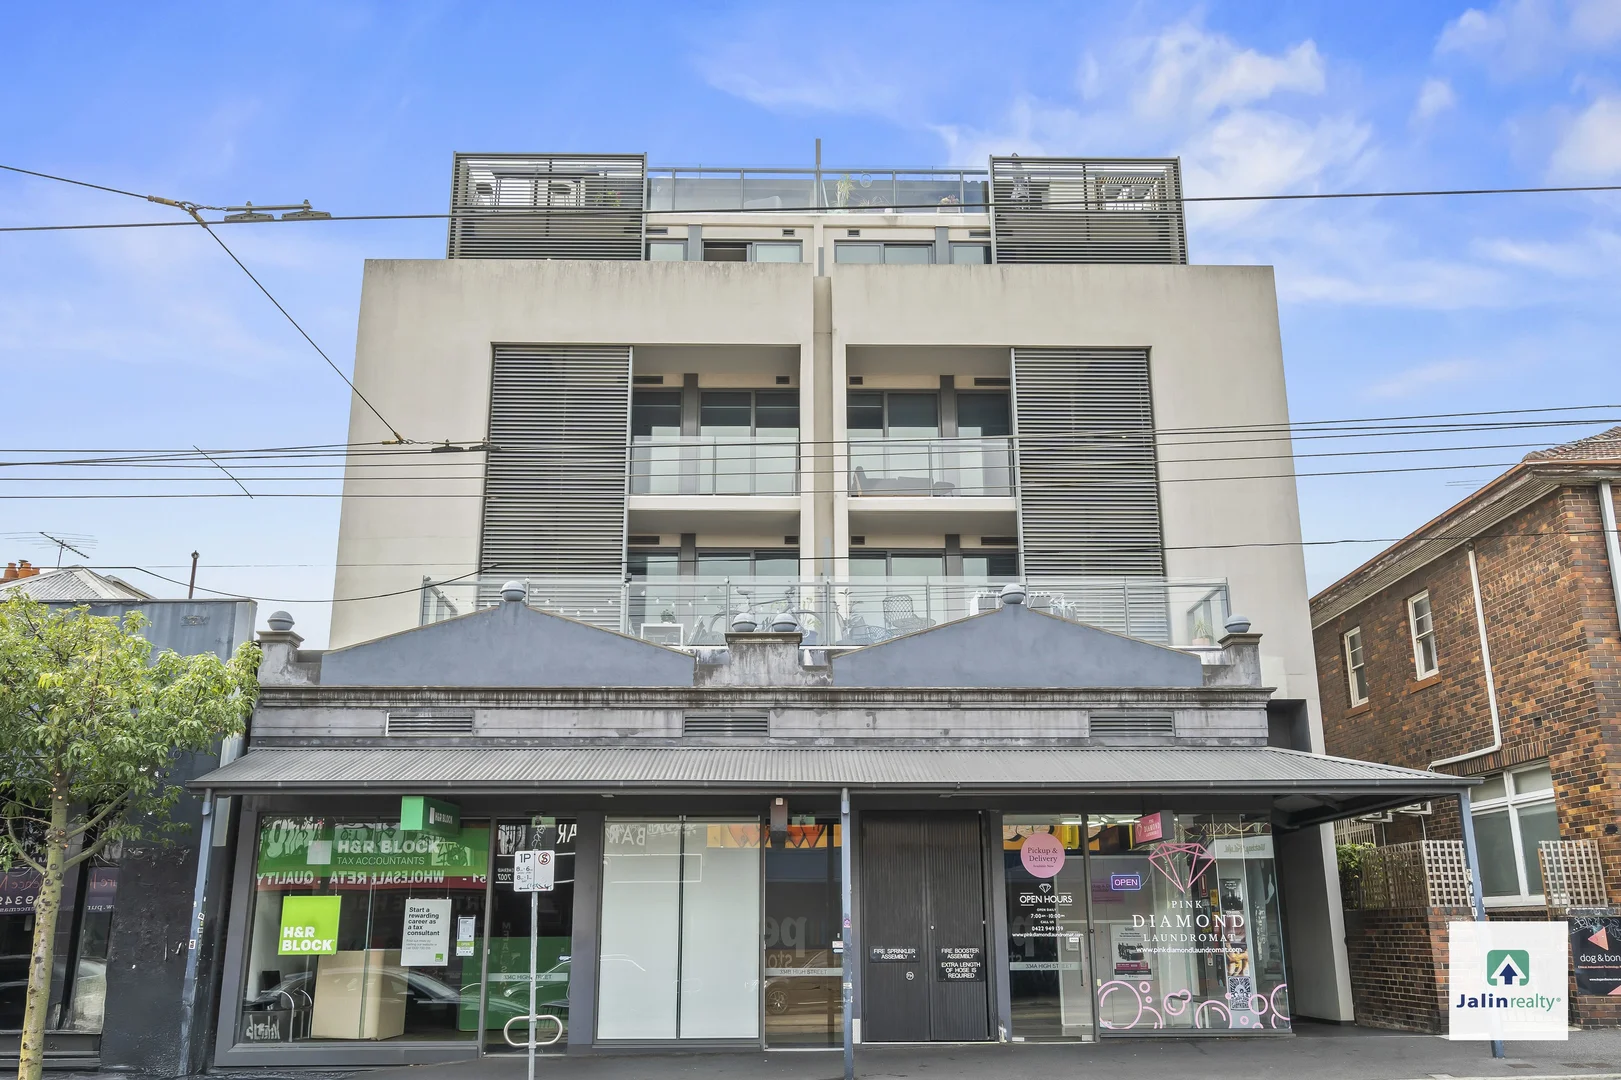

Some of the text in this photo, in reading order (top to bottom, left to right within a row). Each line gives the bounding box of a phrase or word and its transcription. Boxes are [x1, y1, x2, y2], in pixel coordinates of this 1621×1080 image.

[338, 840, 440, 854] H&R BLOCK
[1028, 847, 1051, 855] Pickup
[337, 857, 425, 865] TAX ACCOUNTANTS
[520, 854, 531, 863] 1P
[1029, 855, 1058, 863] Delivery
[1020, 895, 1073, 904] OPEN HOURS
[1171, 901, 1203, 909] PINK
[1132, 915, 1244, 928] DIAMOND
[284, 926, 316, 938] H&R
[1144, 934, 1236, 942] LAUNDROMAT
[282, 939, 333, 952] BLOCK
[1580, 954, 1597, 964] dog
[1598, 954, 1604, 962] &
